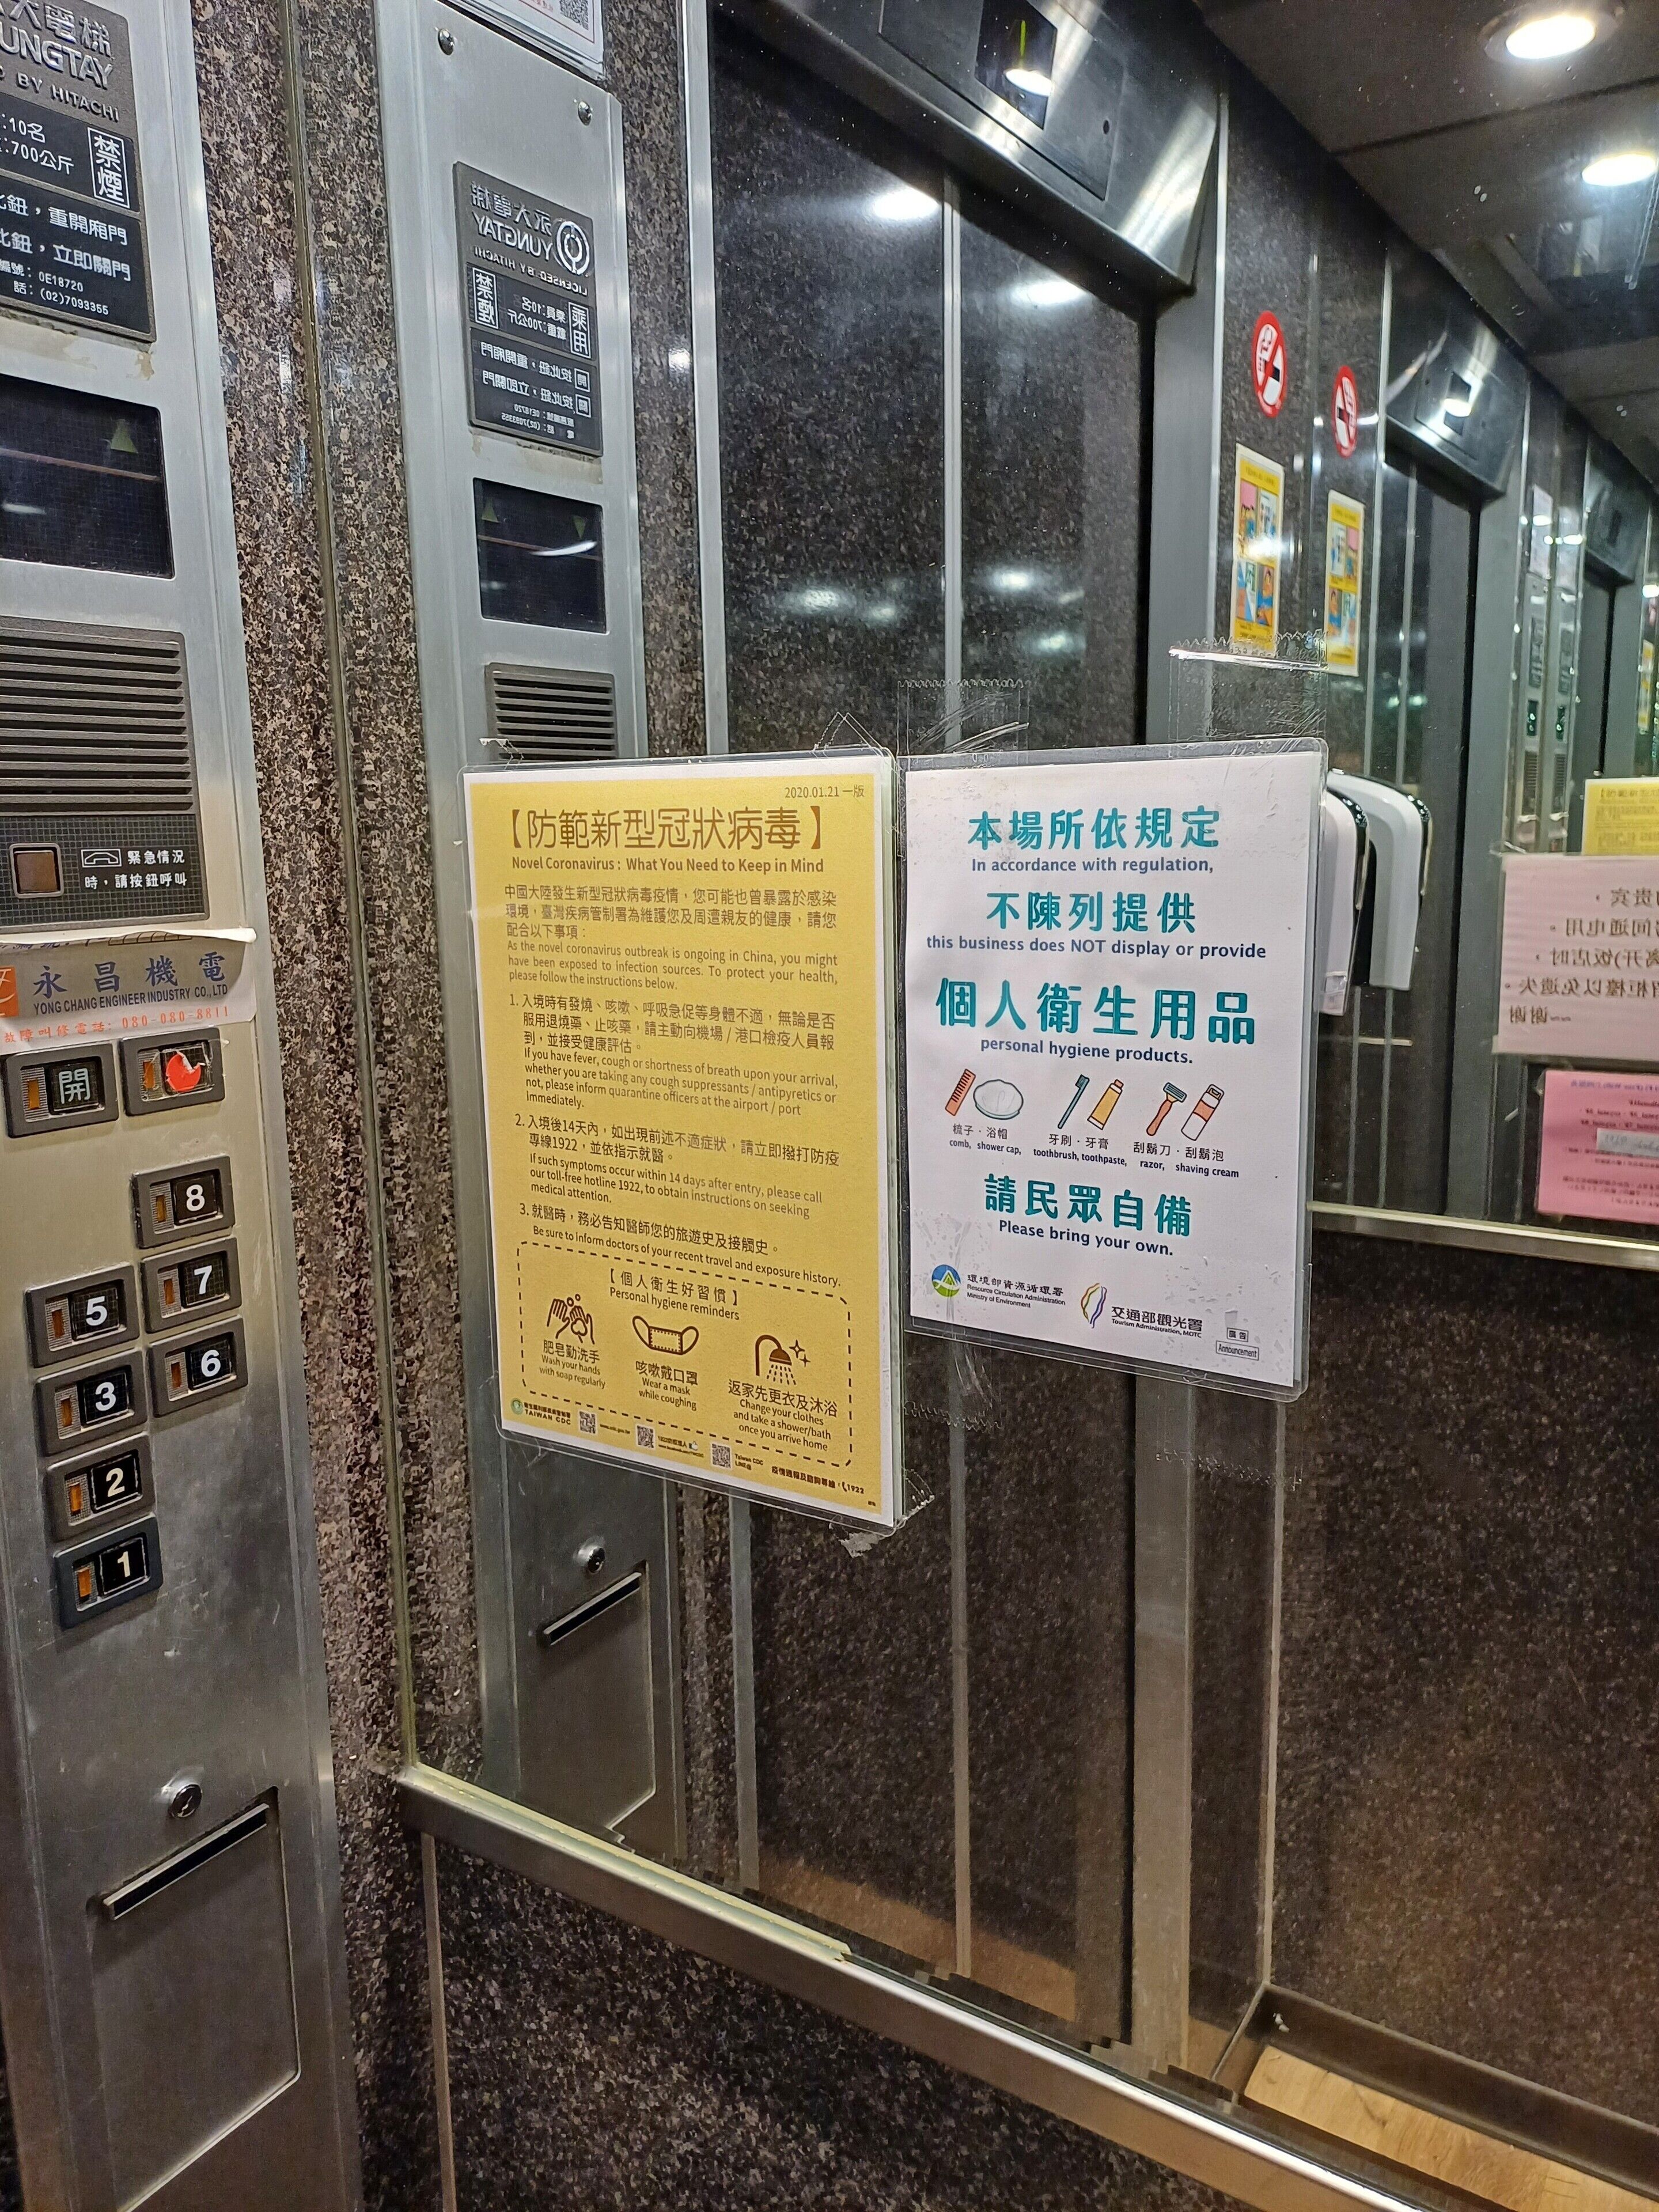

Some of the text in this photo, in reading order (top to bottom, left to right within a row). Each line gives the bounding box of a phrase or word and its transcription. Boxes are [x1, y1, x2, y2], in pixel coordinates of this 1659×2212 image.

[17, 71, 119, 122] BY HITACHI
[94, 135, 124, 203] 禁煙
[785, 786, 839, 798] 2020.01.21
[967, 805, 1219, 850] 本場所依規定
[128, 850, 185, 865] 緊急情況
[512, 856, 543, 869] Novel
[546, 856, 614, 870] Coronavirus
[626, 857, 657, 870] What
[660, 858, 683, 871] You
[687, 858, 718, 871] Need
[721, 859, 734, 872] to
[738, 858, 771, 874] Keep
[775, 858, 787, 872] in
[791, 857, 823, 872] Mind
[972, 857, 1213, 874] In accordance with regulation,
[85, 873, 187, 889] 時，請按鈕呼叫
[986, 891, 1195, 933] 不陳列提供
[927, 935, 1266, 960] this business does NOT display or provide
[33, 1001, 62, 1015] YONG
[64, 997, 97, 1012] CHANG
[99, 992, 146, 1008] ENGINEER
[147, 987, 190, 1003] INDUSTRY
[935, 978, 1255, 1044] 個人衛生用品
[122, 1006, 229, 1029] 080-080-8811
[981, 1040, 1192, 1063] personal hygiene products.
[58, 1067, 90, 1105] 開
[949, 1139, 1021, 1155] comb, shower cap,
[1033, 1149, 1127, 1166] toothbrush, toothpaste,
[1140, 1161, 1238, 1177] razor, shaving cream
[185, 1185, 206, 1211] 8
[984, 1173, 1191, 1237] 請民眾自備
[999, 1219, 1172, 1255] Please bring your own.
[194, 1266, 213, 1295] 7
[610, 1286, 739, 1320] Personal hygiene reminders
[967, 1283, 1065, 1305] Resource Circulation Administration
[967, 1291, 988, 1302] Ministry
[995, 1297, 1031, 1308] Environment
[86, 1296, 108, 1327] 5
[1111, 1306, 1202, 1331] 交通部觀光署
[1112, 1318, 1201, 1338] Tourism Administration, MOTC
[1218, 1344, 1257, 1357] Announcement
[200, 1351, 221, 1378] 6
[541, 1354, 600, 1375] Wash your hands
[539, 1367, 605, 1389] with soap regularly
[642, 1377, 661, 1389] Wear
[669, 1384, 690, 1395] mask
[95, 1383, 116, 1411] 3
[639, 1388, 696, 1411] while coughing
[525, 1409, 552, 1421] TAIWAN
[555, 1416, 571, 1425] CDC
[740, 1399, 824, 1426] Change your clothes
[733, 1411, 749, 1421] and
[751, 1414, 768, 1425] take
[777, 1419, 831, 1440] shower/bath
[738, 1425, 828, 1451] once you arrive home
[106, 1469, 126, 1497] 2
[847, 1483, 864, 1494] 1922
[118, 1552, 131, 1579] 1
